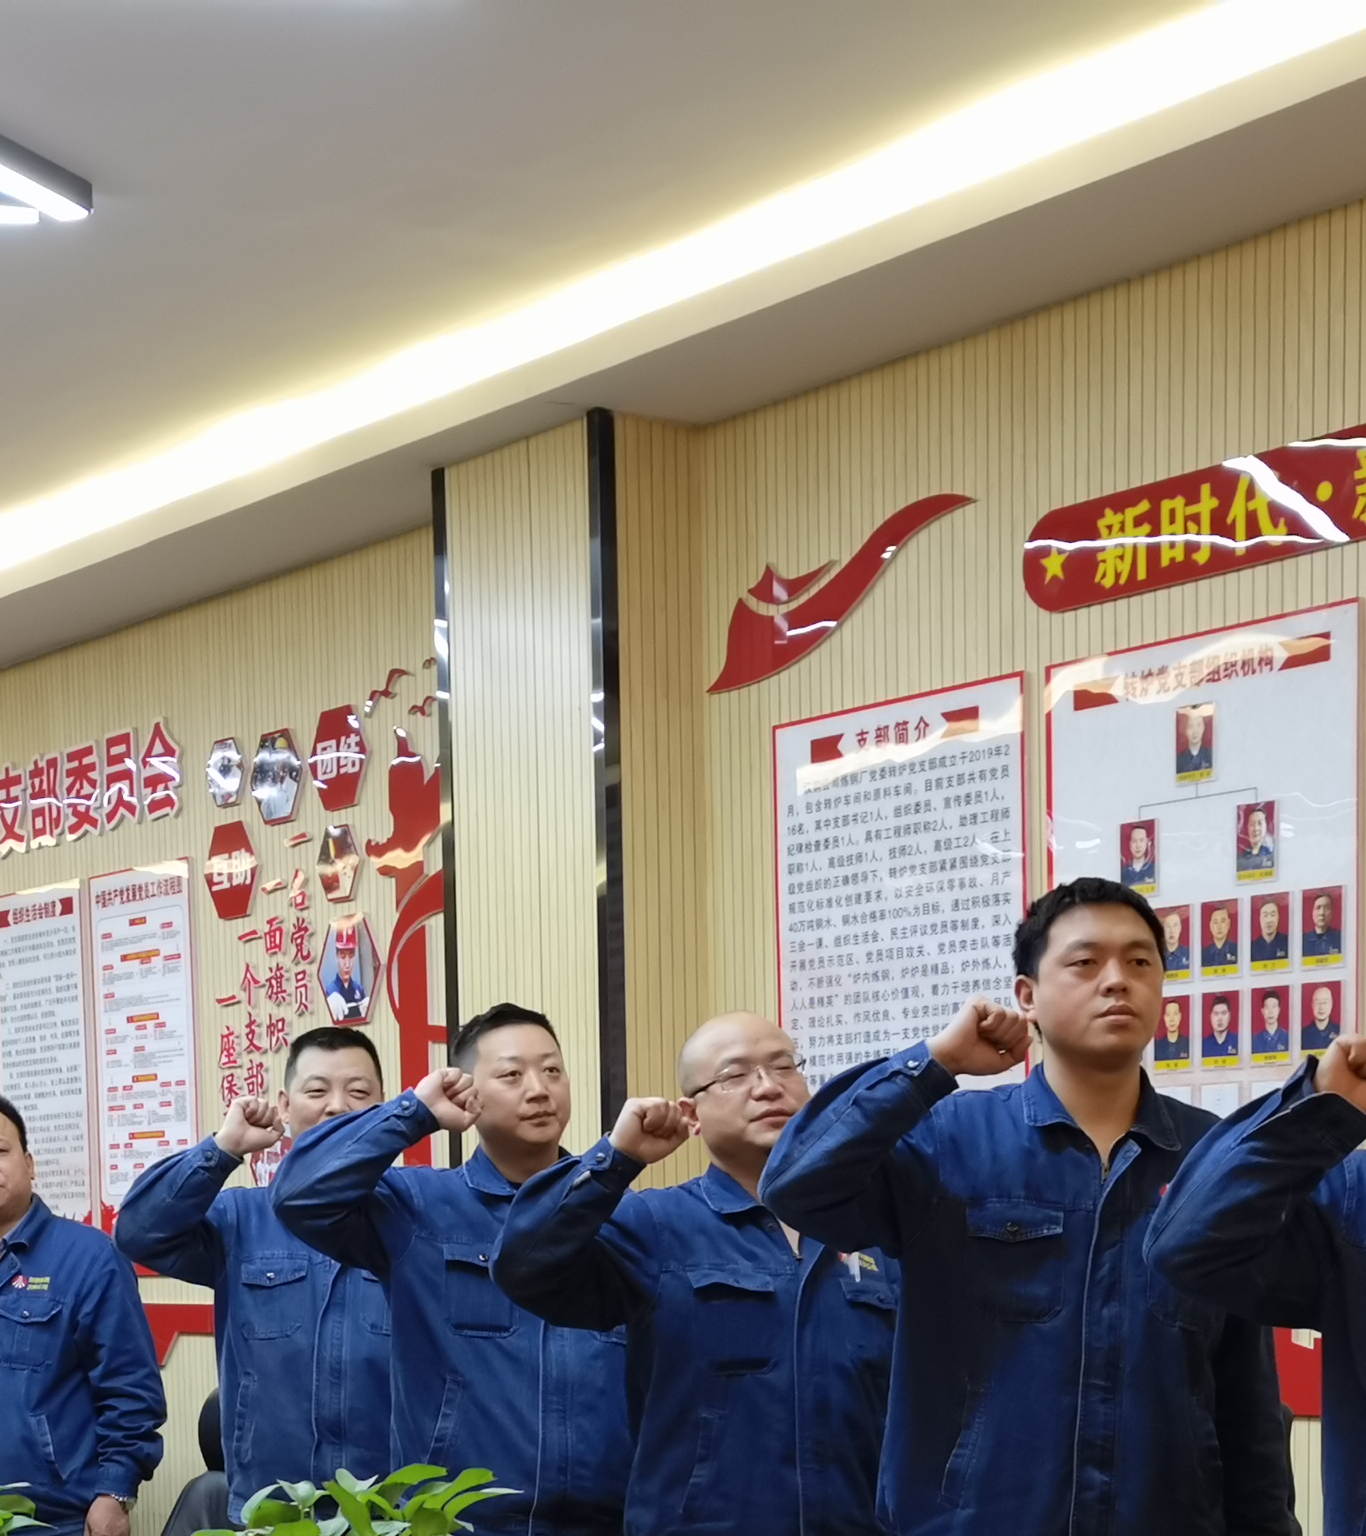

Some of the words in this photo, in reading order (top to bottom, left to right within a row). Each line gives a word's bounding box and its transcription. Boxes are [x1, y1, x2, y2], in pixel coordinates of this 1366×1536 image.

[1123, 645, 1275, 700] 转炉党支部组织机构
[315, 735, 362, 781] 团结
[855, 714, 931, 754] 支部简介
[804, 742, 1010, 795] 司炼钢厂党委转炉党支部成立于2019年2
[211, 849, 252, 893] 互助
[284, 832, 314, 1014] 一名党员
[261, 878, 289, 1051] 一面旗帜
[237, 929, 265, 1098] 一个支部
